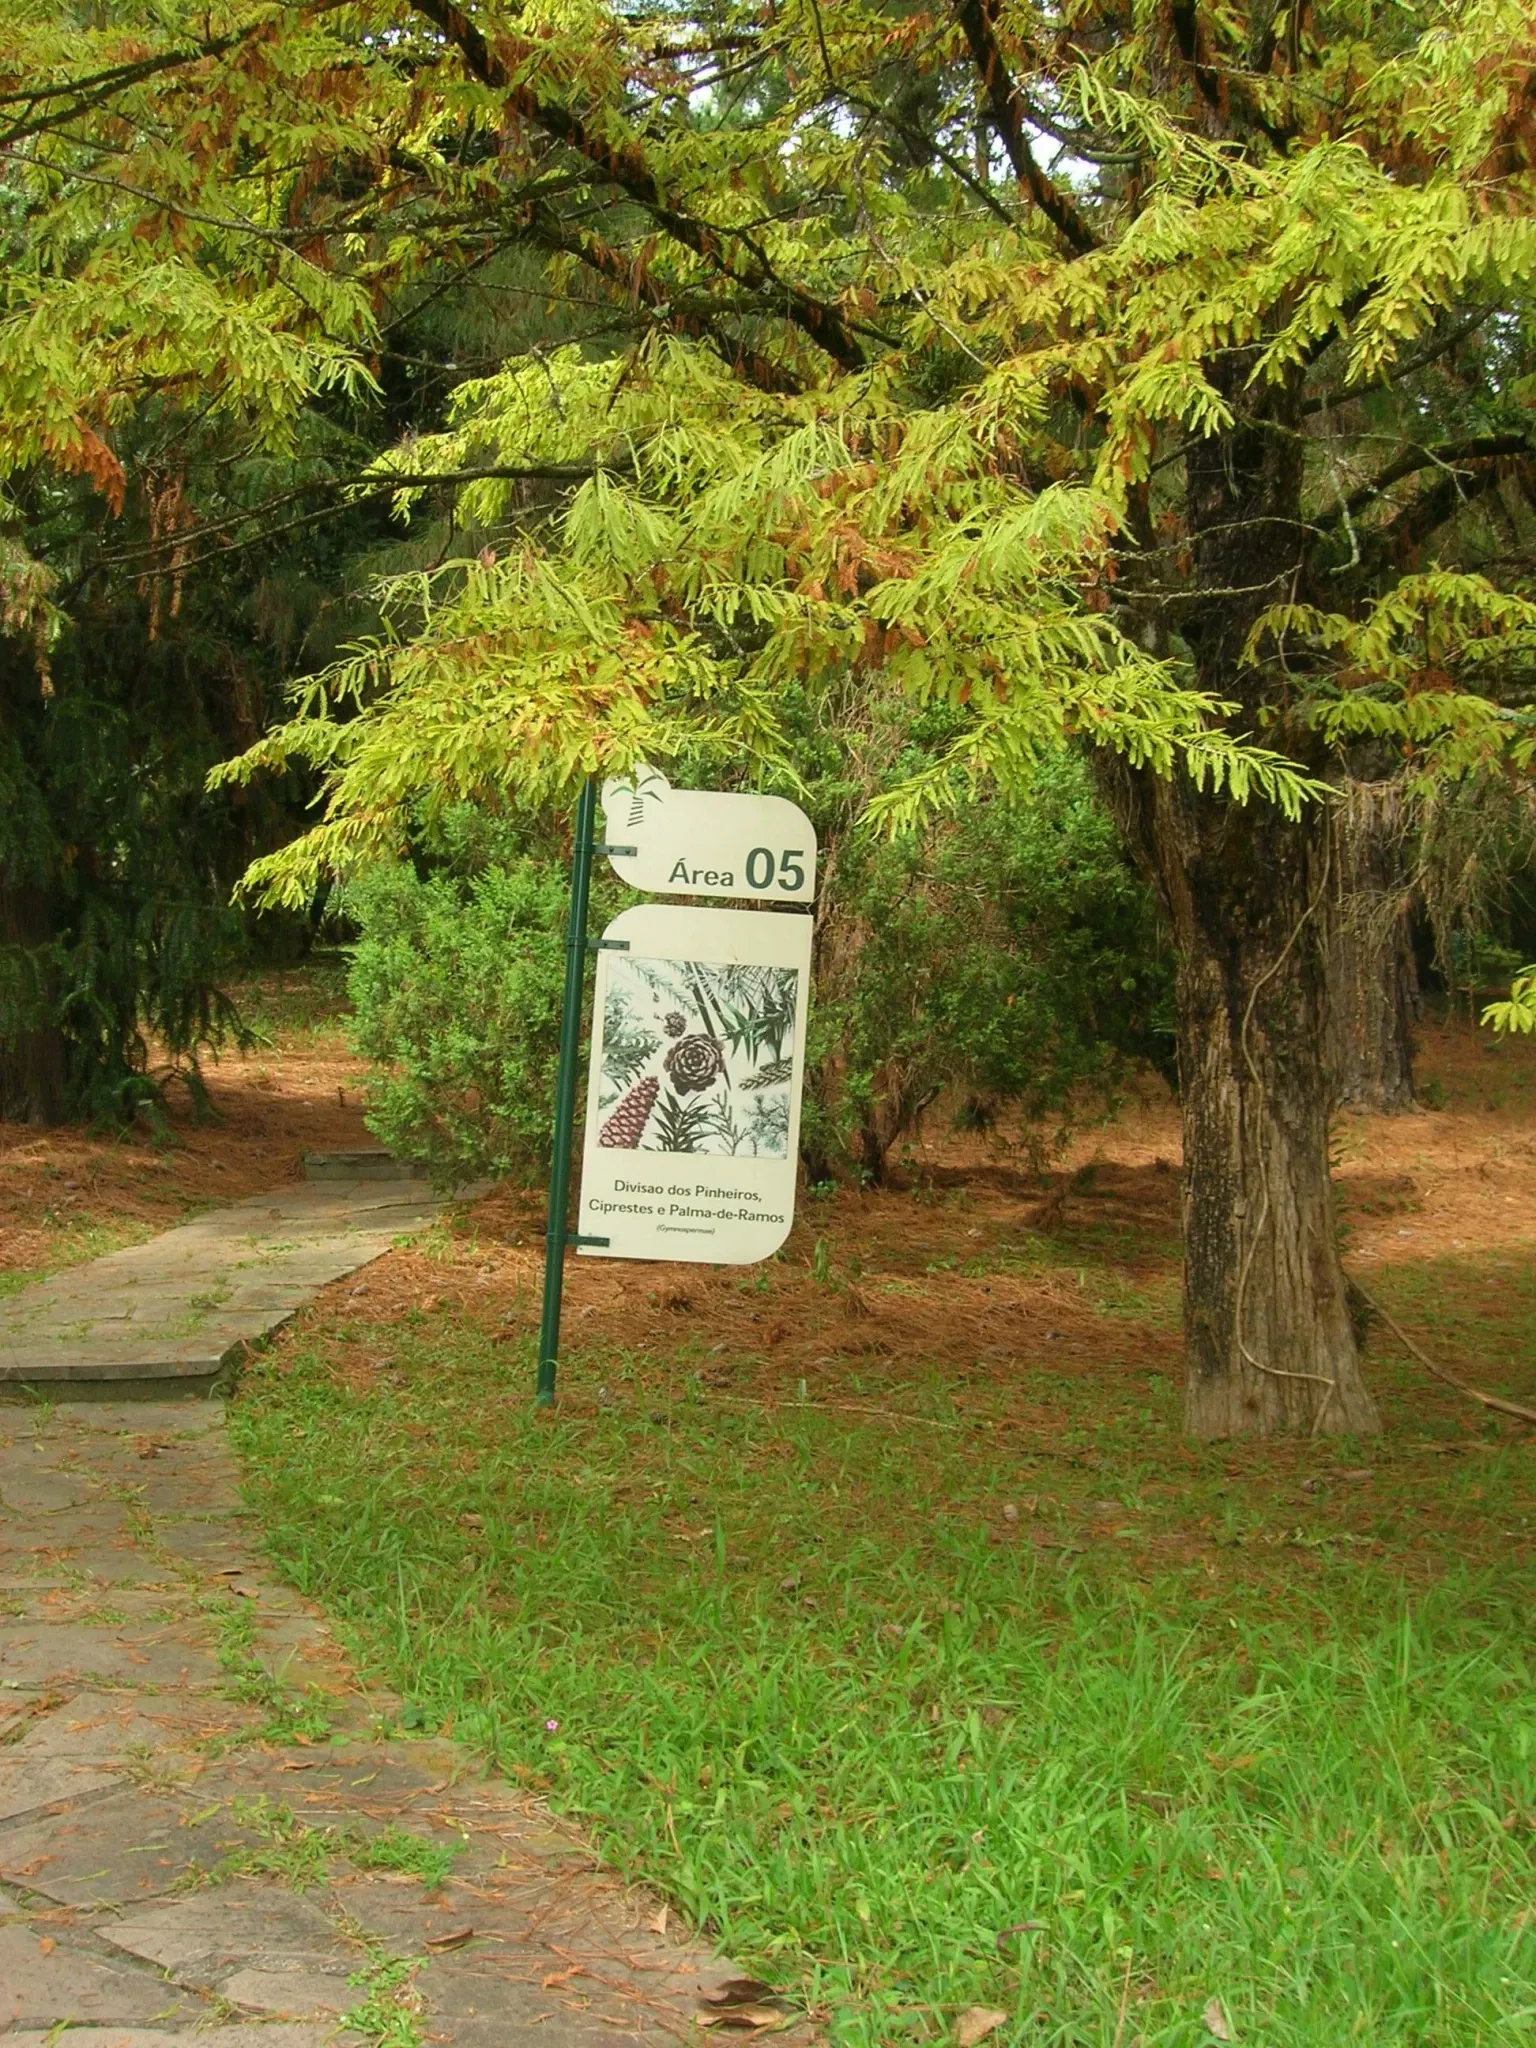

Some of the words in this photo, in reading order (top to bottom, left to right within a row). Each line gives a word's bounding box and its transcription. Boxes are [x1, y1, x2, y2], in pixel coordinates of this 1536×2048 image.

[668, 857, 735, 887] Área
[745, 847, 805, 891] 05
[614, 1180, 664, 1195] Divisao
[667, 1184, 691, 1197] dos
[695, 1185, 762, 1203] Pinheiros,
[589, 1199, 653, 1215] Ciprestes
[657, 1207, 666, 1215] e
[669, 1205, 785, 1223] Palma-de-Ramos
